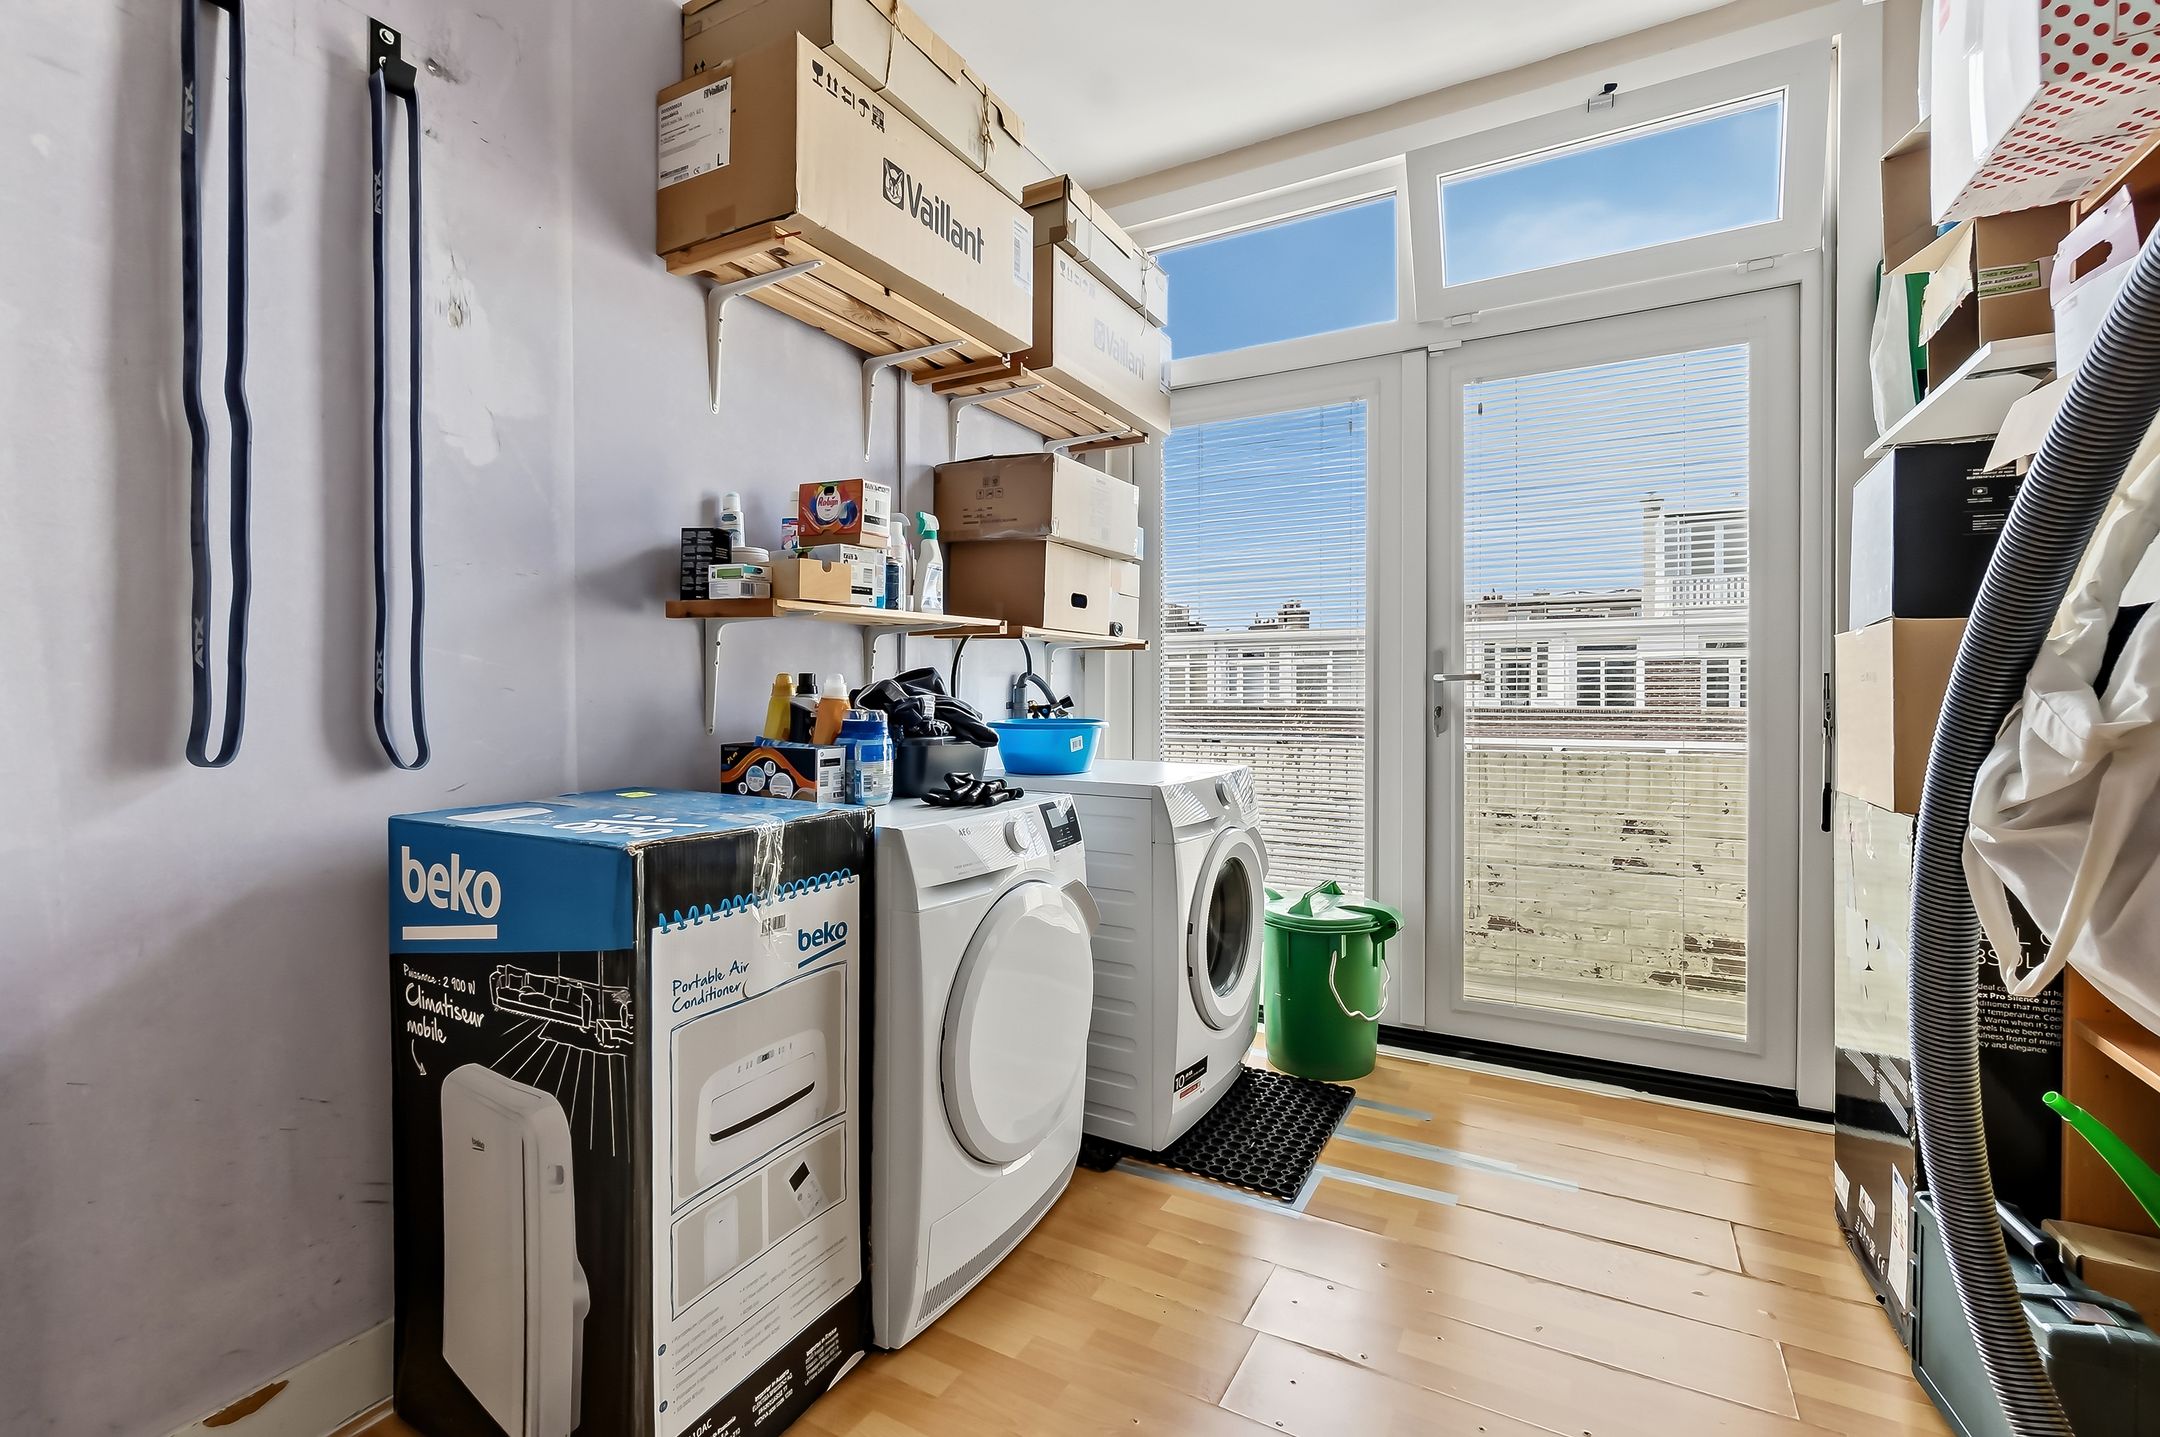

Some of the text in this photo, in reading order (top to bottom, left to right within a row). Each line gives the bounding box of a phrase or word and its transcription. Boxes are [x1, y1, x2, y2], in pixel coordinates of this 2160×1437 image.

[717, 153, 724, 167] L
[906, 174, 985, 265] Vaillant
[1106, 326, 1147, 381] Vaillant
[194, 616, 205, 669] ATX
[401, 845, 502, 919] beko
[797, 920, 848, 951] beko
[442, 976, 450, 988] 2
[672, 959, 750, 997] Portable Air
[1977, 983, 1996, 991] deal
[405, 982, 485, 1028] Climatiseur
[671, 980, 742, 1014] Conditioner
[1978, 1000, 2011, 1009] ditioner
[2013, 1003, 2031, 1011] that
[1989, 992, 2006, 1000] Pro
[2007, 994, 2040, 1003] Silence
[406, 1015, 448, 1044] mobile
[1984, 1016, 2009, 1025] Warm
[2010, 1019, 2034, 1028] when
[1999, 1026, 2020, 1035] have
[2021, 1028, 2044, 1037] been
[2005, 1034, 2027, 1043] front
[2028, 1037, 2038, 1045] of
[1175, 1074, 1185, 1091] 10
